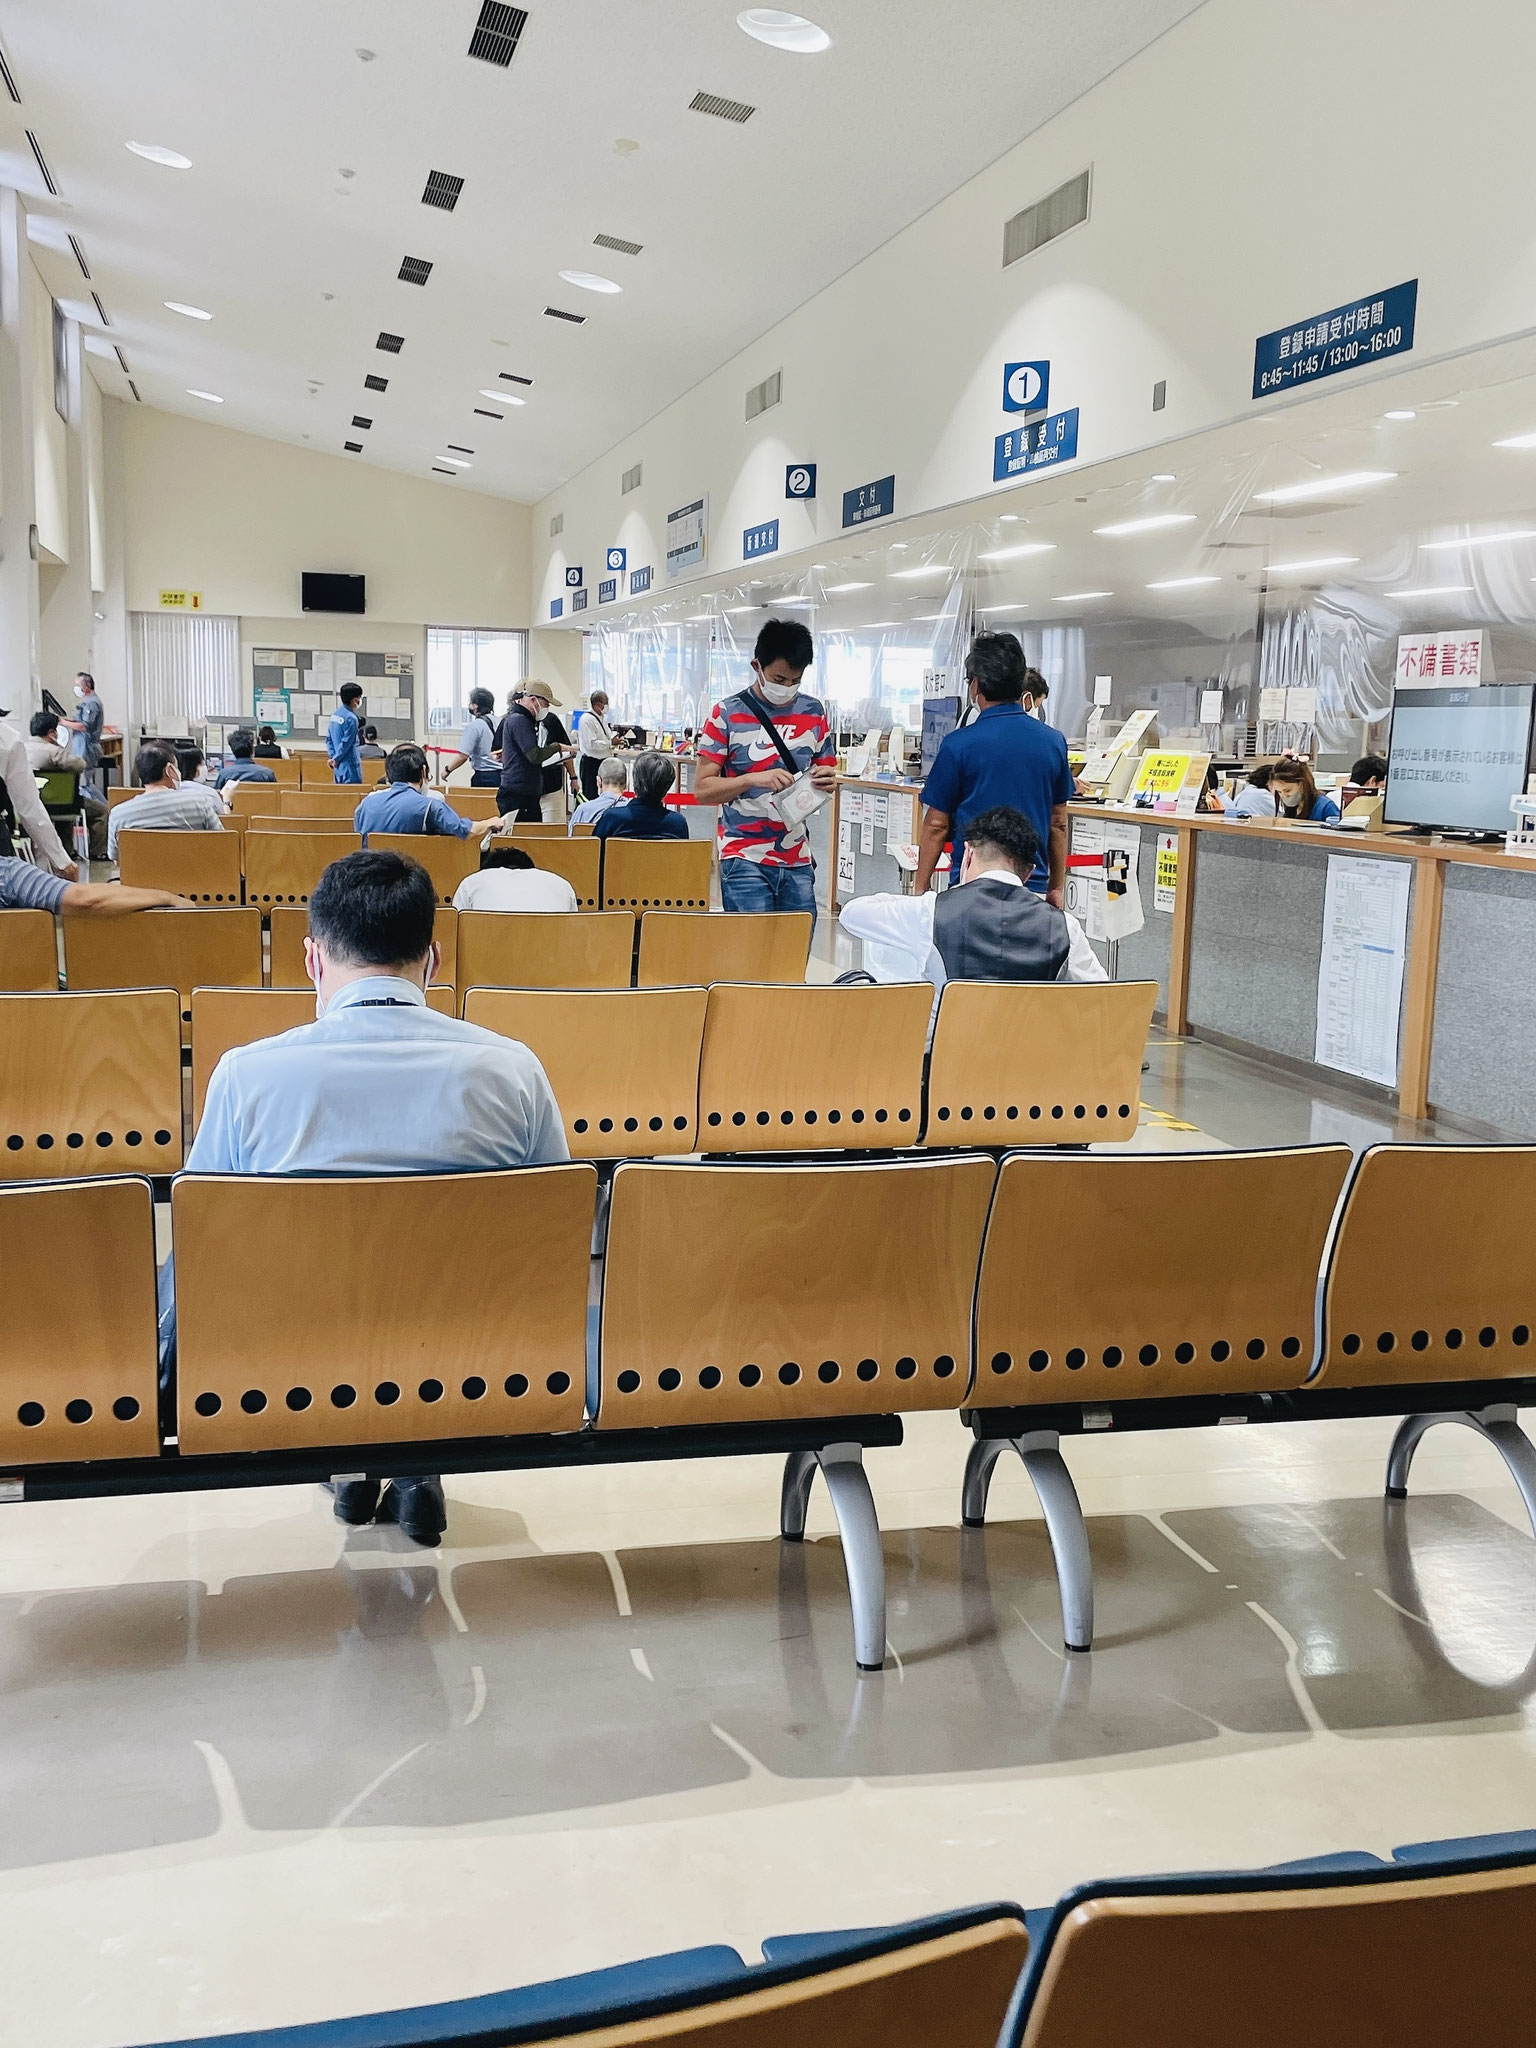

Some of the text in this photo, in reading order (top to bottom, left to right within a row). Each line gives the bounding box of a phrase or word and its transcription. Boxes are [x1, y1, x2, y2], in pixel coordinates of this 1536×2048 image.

[1278, 300, 1385, 360] 登録申請受付時間
[1018, 372, 1028, 399] 1
[794, 472, 805, 491] 2
[859, 485, 876, 508] 交付
[612, 552, 620, 566] 3
[1399, 641, 1480, 678] 不備書類
